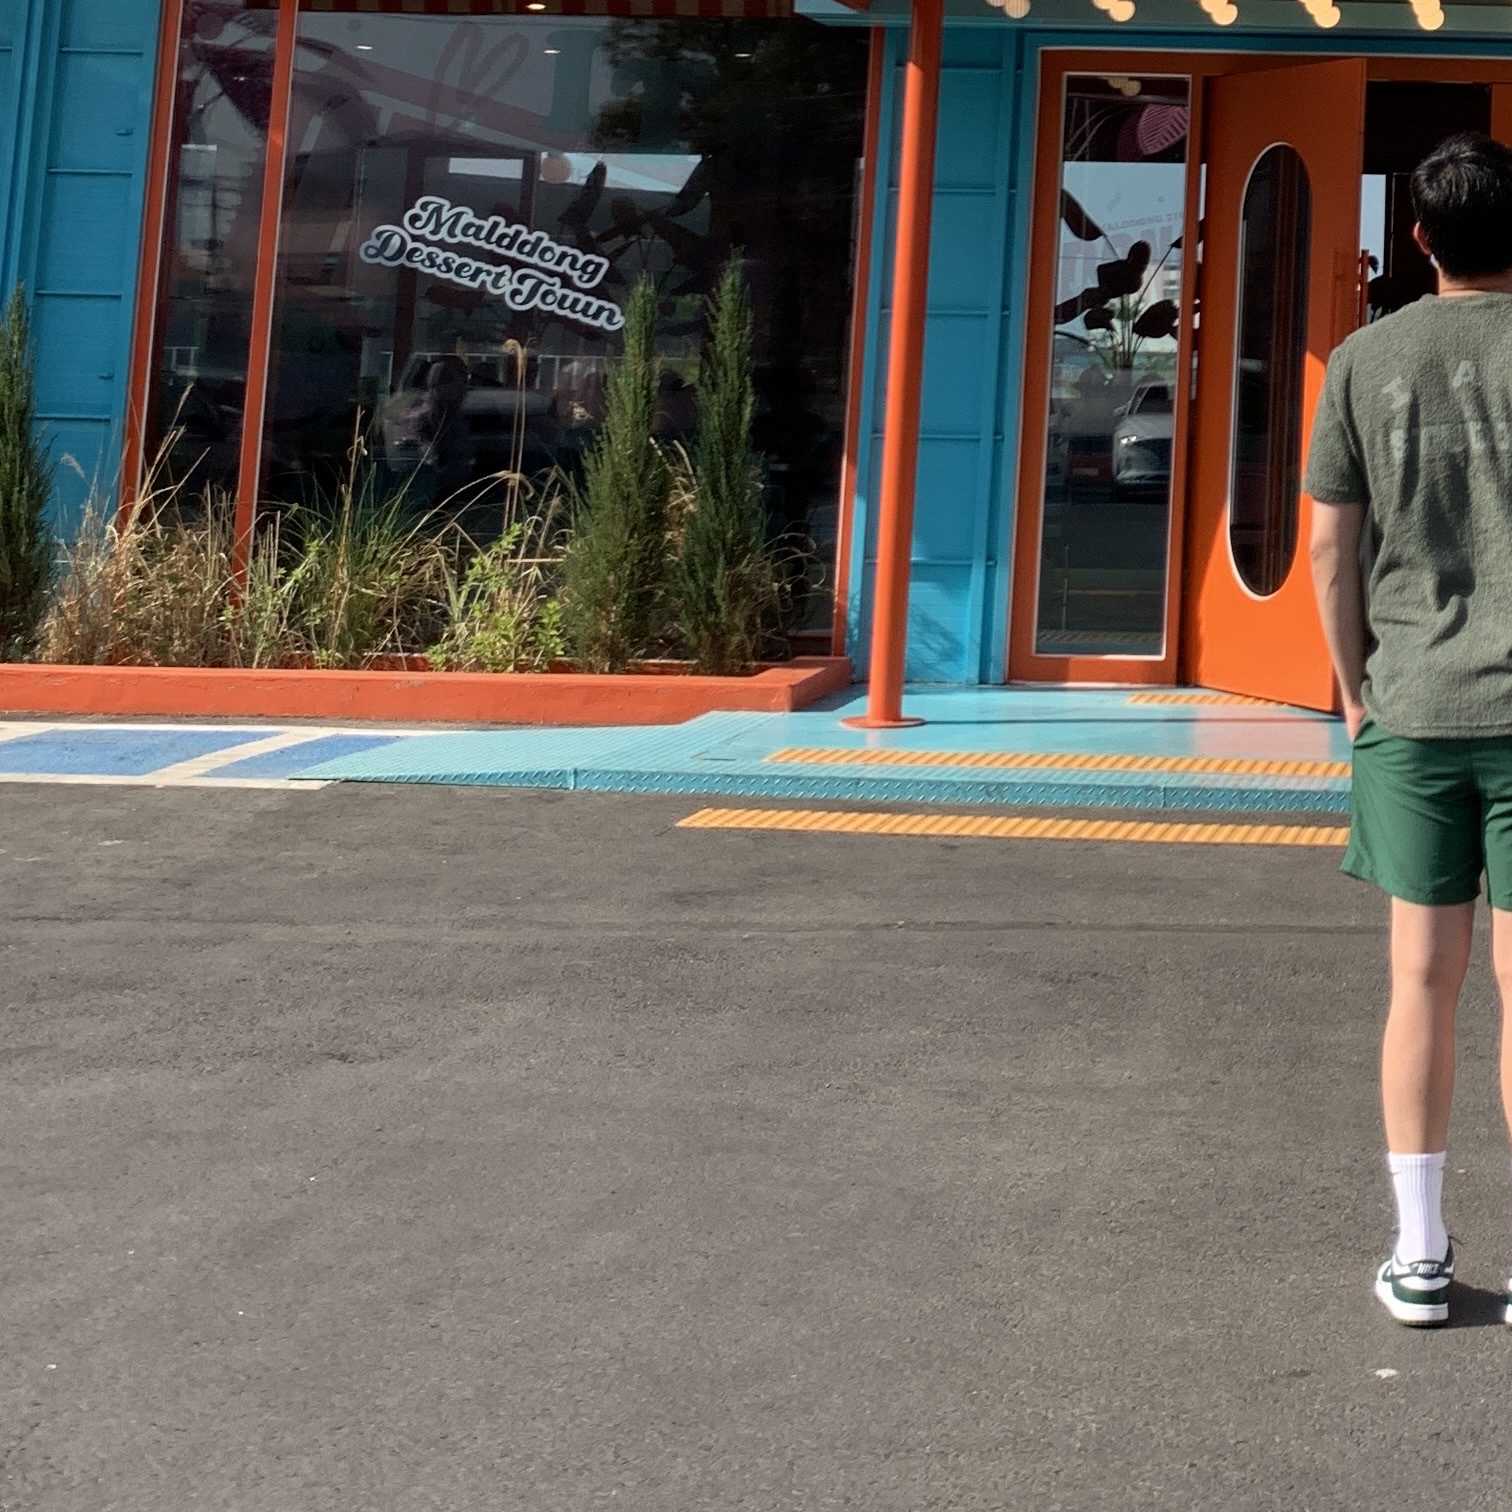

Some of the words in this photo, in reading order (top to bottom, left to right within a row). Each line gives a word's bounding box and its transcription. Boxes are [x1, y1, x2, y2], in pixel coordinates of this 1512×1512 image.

[360, 225, 513, 294] Dessert
[506, 268, 625, 331] Town
[404, 196, 610, 288] Malddong
